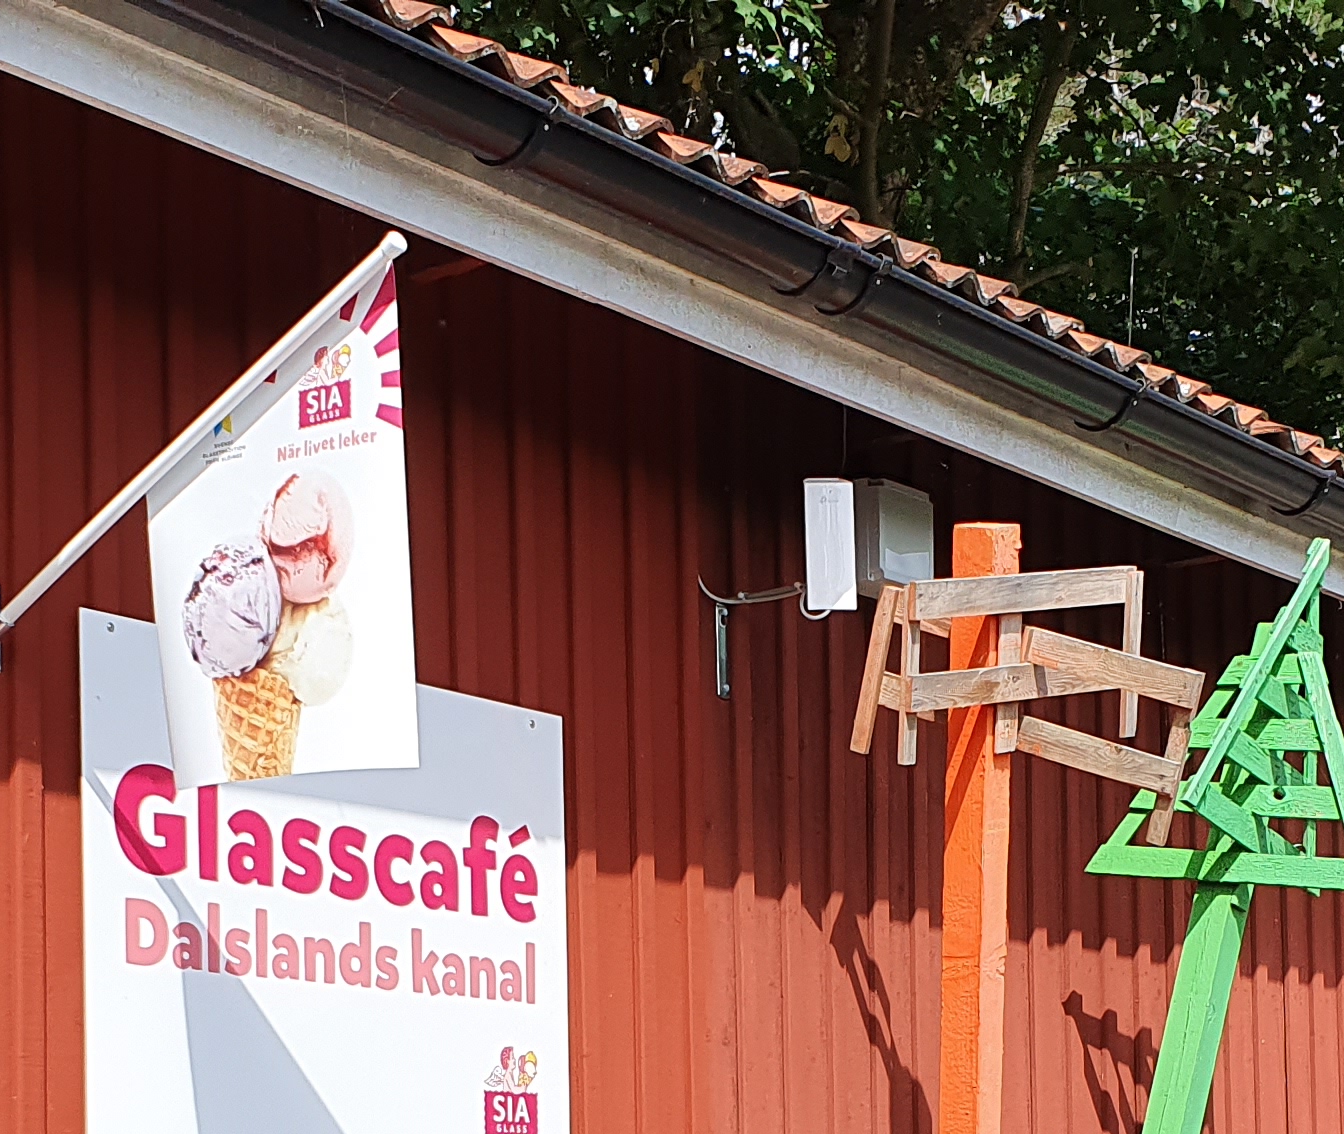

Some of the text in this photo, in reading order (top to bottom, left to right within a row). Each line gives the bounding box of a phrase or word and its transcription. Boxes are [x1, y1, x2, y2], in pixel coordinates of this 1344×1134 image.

[306, 385, 343, 415] SIA
[309, 409, 341, 423] GLASS
[277, 429, 377, 462] När livet leker
[114, 763, 538, 922] Glasscafé
[125, 897, 536, 1004] Dalslands kanal
[493, 1094, 531, 1123] SIA
[496, 1123, 528, 1134] GLASS
